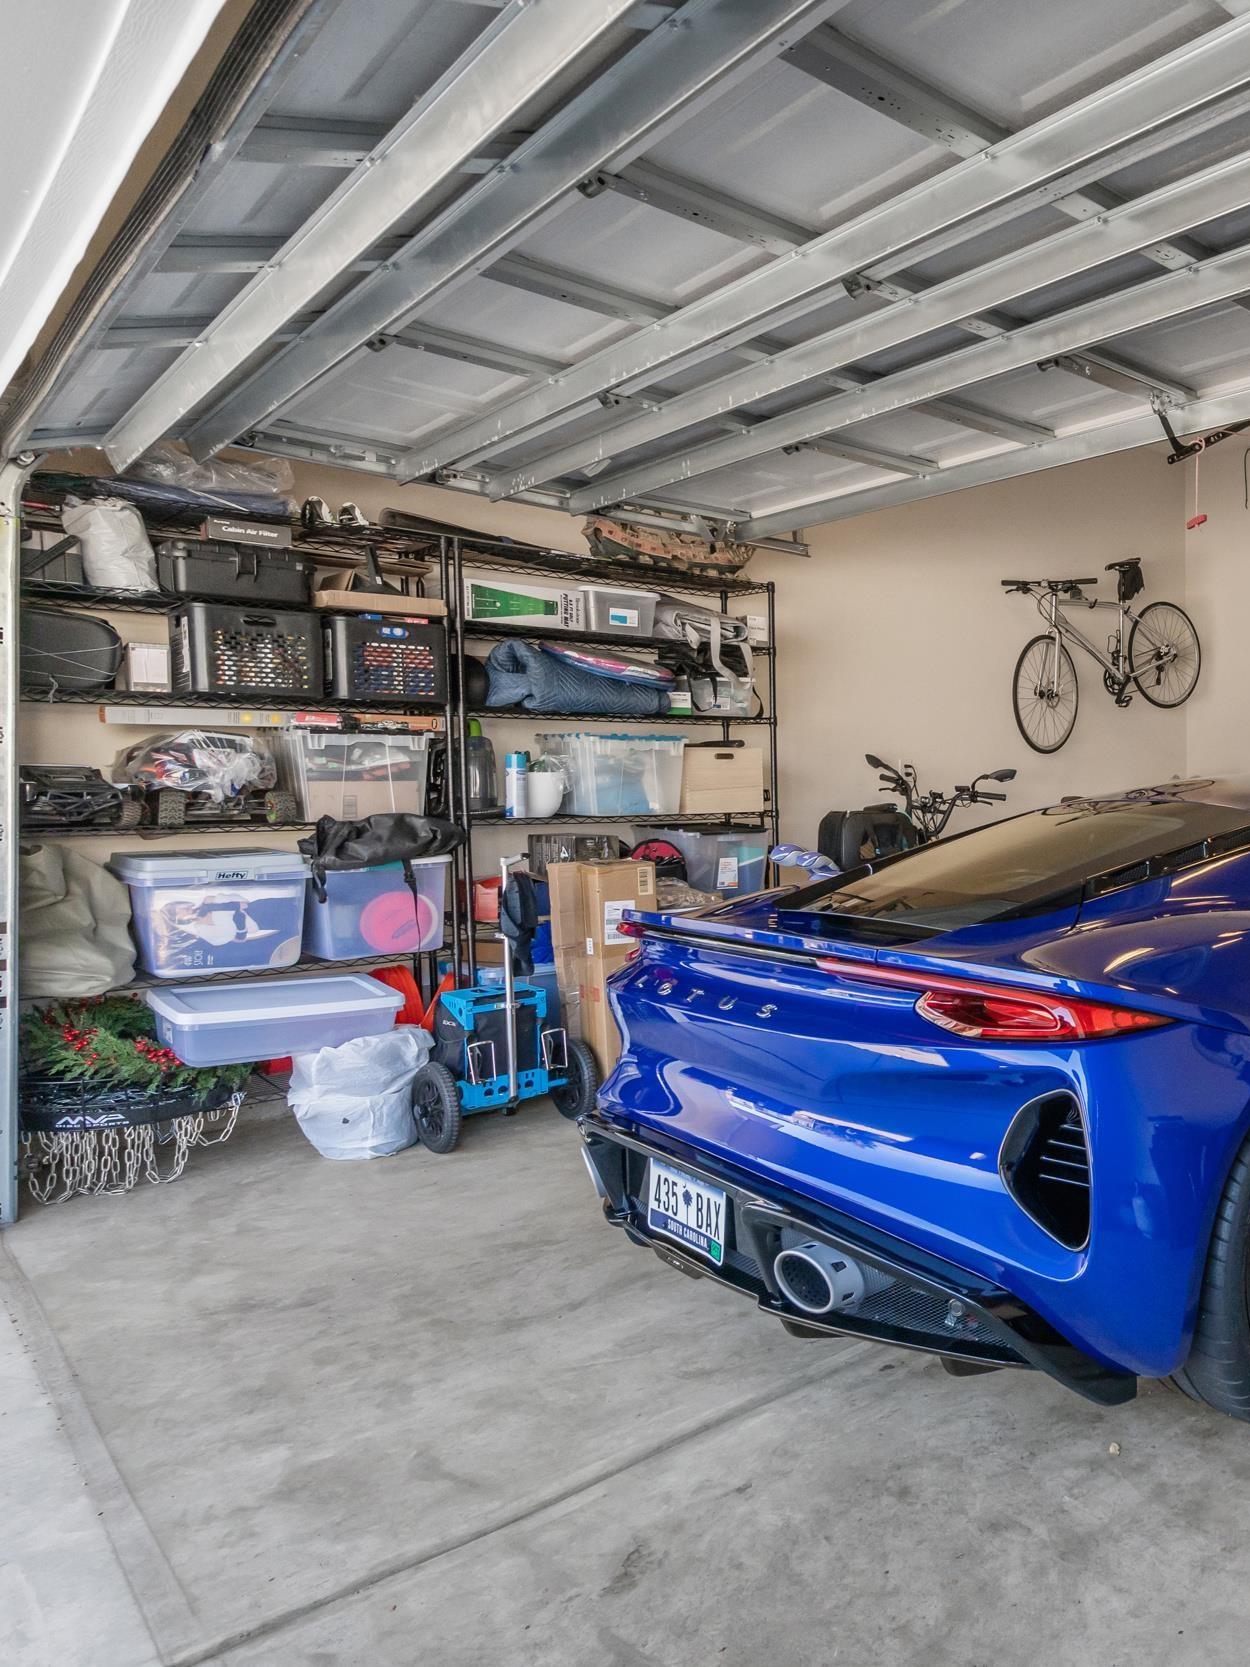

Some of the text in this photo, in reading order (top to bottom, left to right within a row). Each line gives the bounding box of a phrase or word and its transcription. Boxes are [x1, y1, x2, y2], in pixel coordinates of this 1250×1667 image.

[222, 525, 245, 534] Cabin
[258, 530, 279, 538] Filter
[635, 975, 778, 1018] LOTUS
[56, 1114, 126, 1125] MVP
[654, 1174, 679, 1217] 435
[696, 1192, 721, 1241] BAX
[667, 1218, 709, 1249] SOUTH CAROLINA
